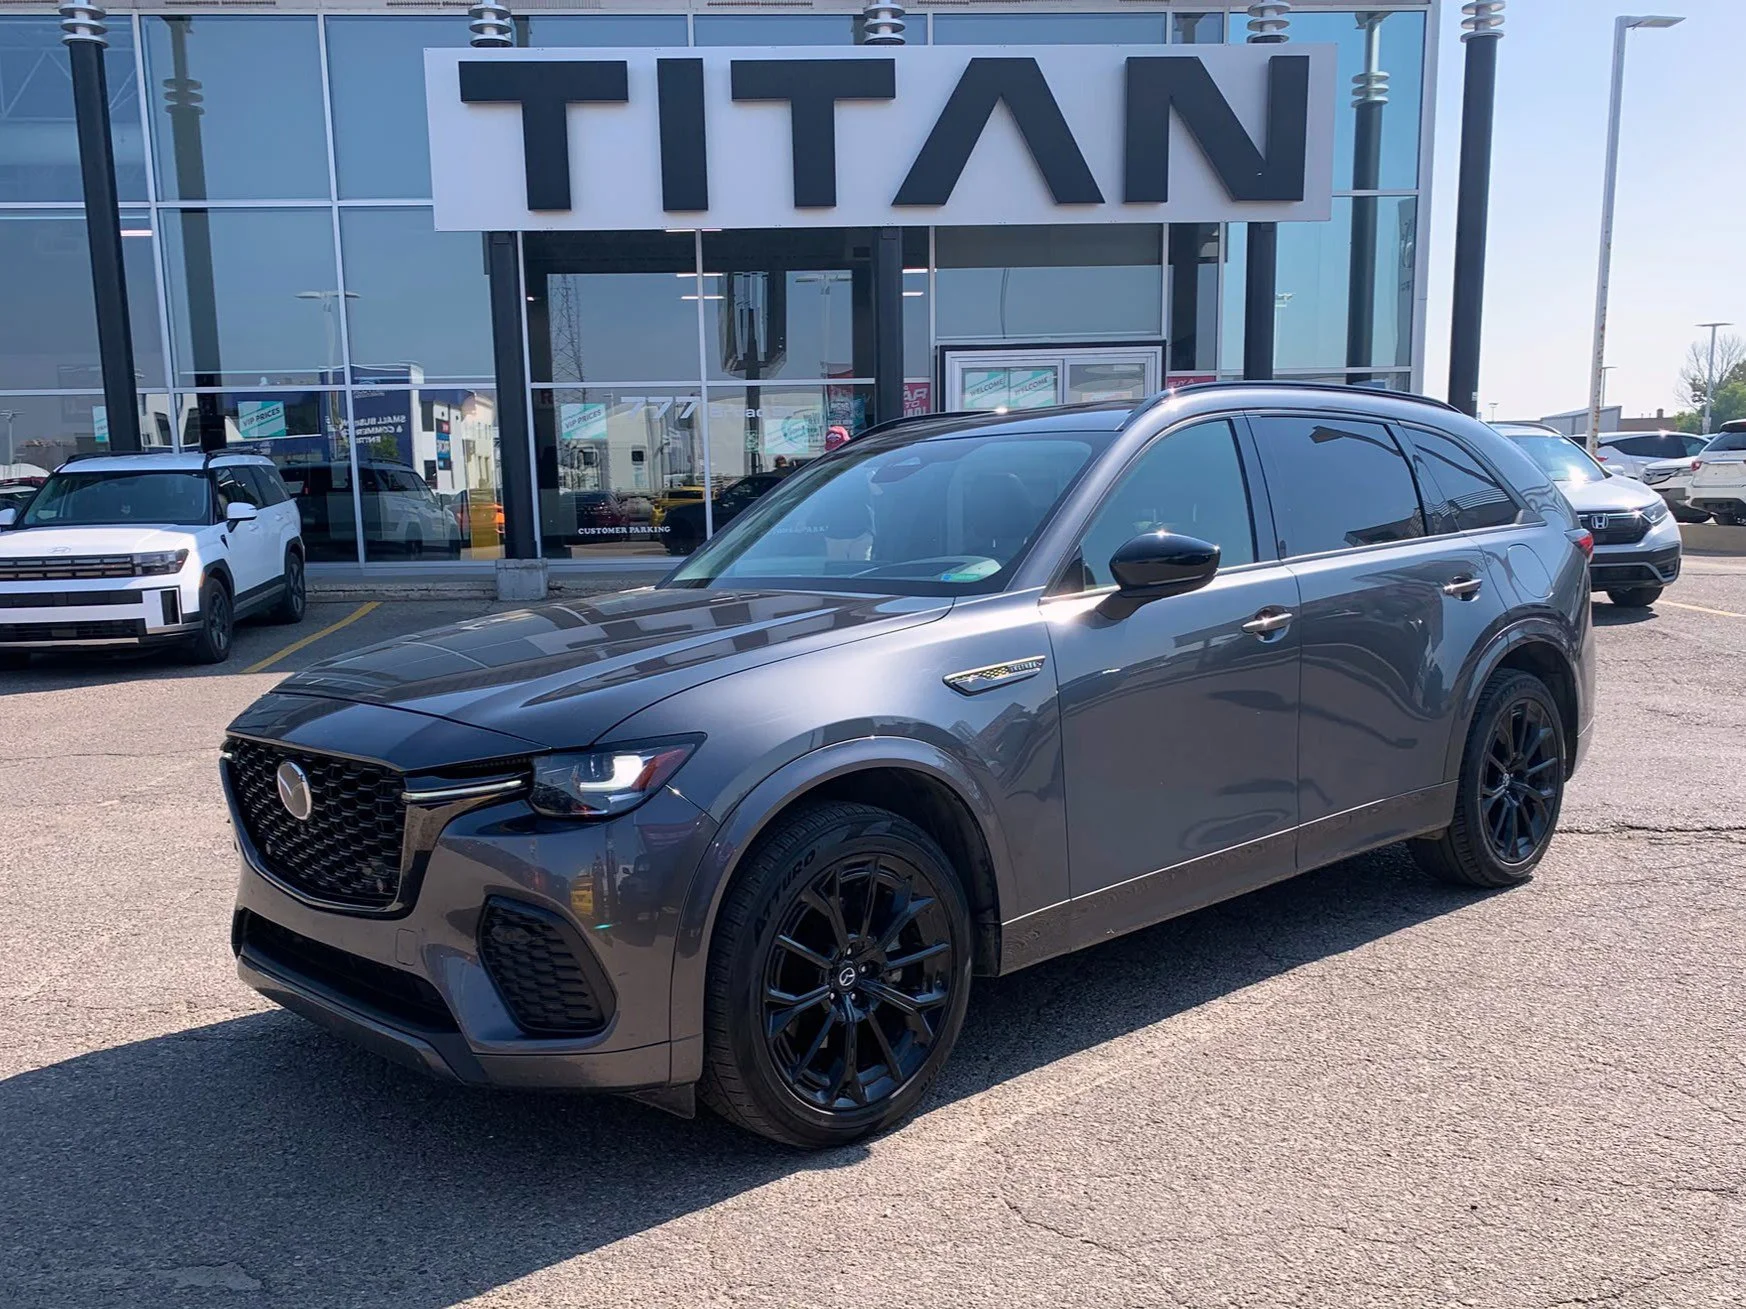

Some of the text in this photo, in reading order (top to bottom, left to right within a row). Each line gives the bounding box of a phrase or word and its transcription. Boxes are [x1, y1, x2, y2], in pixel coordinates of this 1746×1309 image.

[458, 55, 1310, 212] TITAN
[969, 377, 1005, 397] WELCOME
[1014, 376, 1048, 396] WELCOME
[903, 387, 928, 401] AR
[255, 407, 280, 422] PRICES
[577, 409, 602, 424] PRICES
[577, 526, 672, 535] CUSTOMER PARKING
